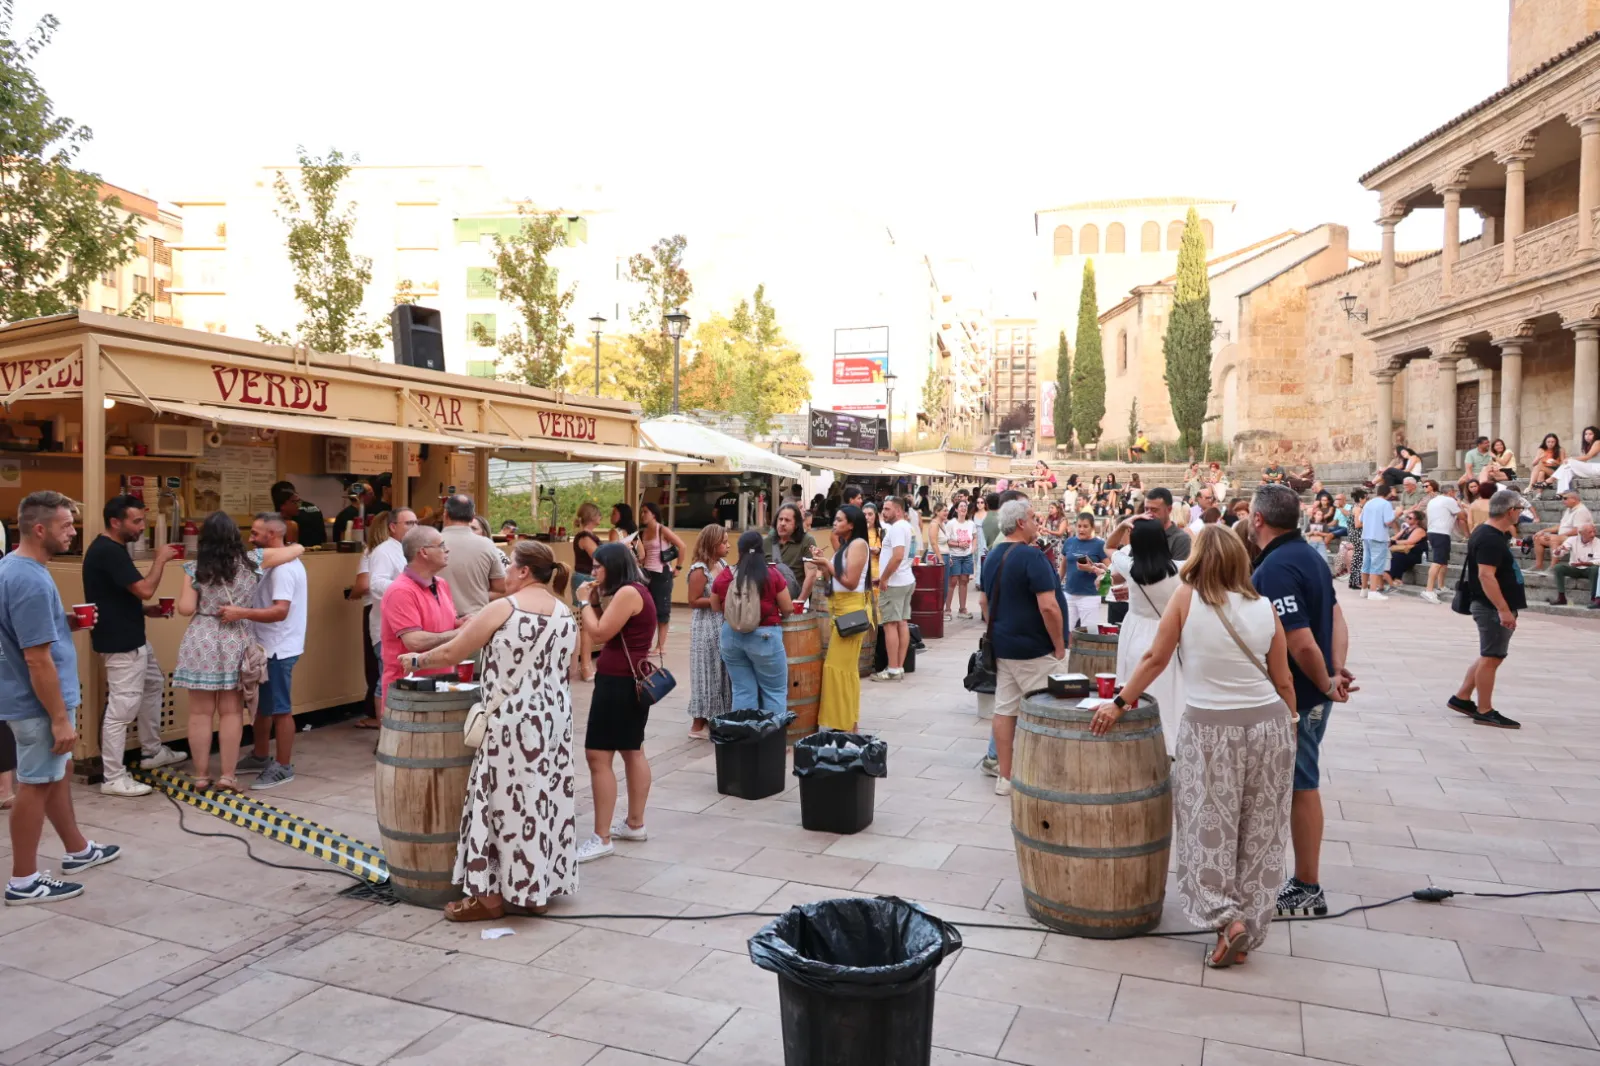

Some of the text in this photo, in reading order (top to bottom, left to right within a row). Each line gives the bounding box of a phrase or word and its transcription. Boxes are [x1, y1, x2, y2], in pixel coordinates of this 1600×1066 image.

[211, 364, 330, 412] VERDI
[418, 394, 463, 426] BAR
[537, 411, 597, 440] VERDI
[816, 428, 828, 438] 101
[1272, 595, 1298, 616] 35
